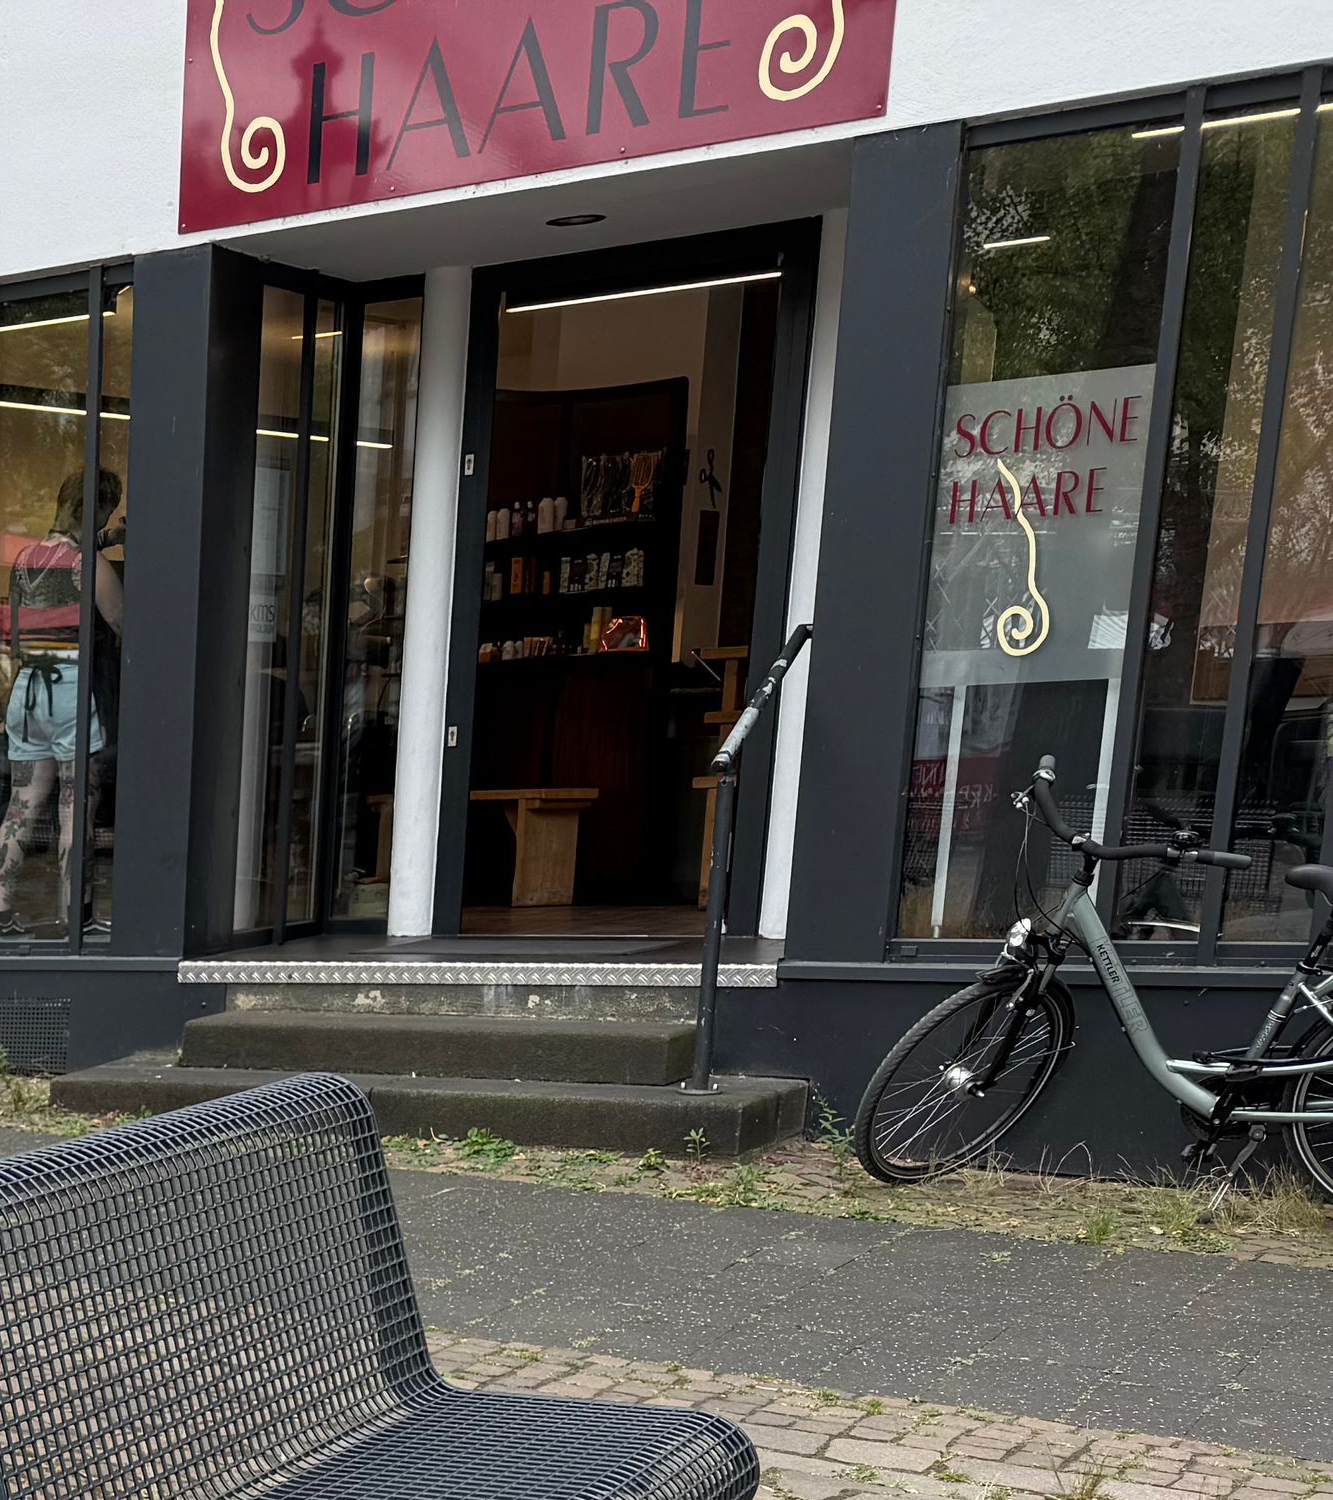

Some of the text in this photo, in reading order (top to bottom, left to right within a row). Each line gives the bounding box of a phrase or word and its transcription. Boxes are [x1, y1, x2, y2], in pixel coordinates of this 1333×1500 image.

[306, 0, 732, 185] HAARE
[954, 394, 1142, 459] SCHÖNE
[948, 467, 1108, 525] HAARE
[1096, 943, 1120, 983] KETTLER
